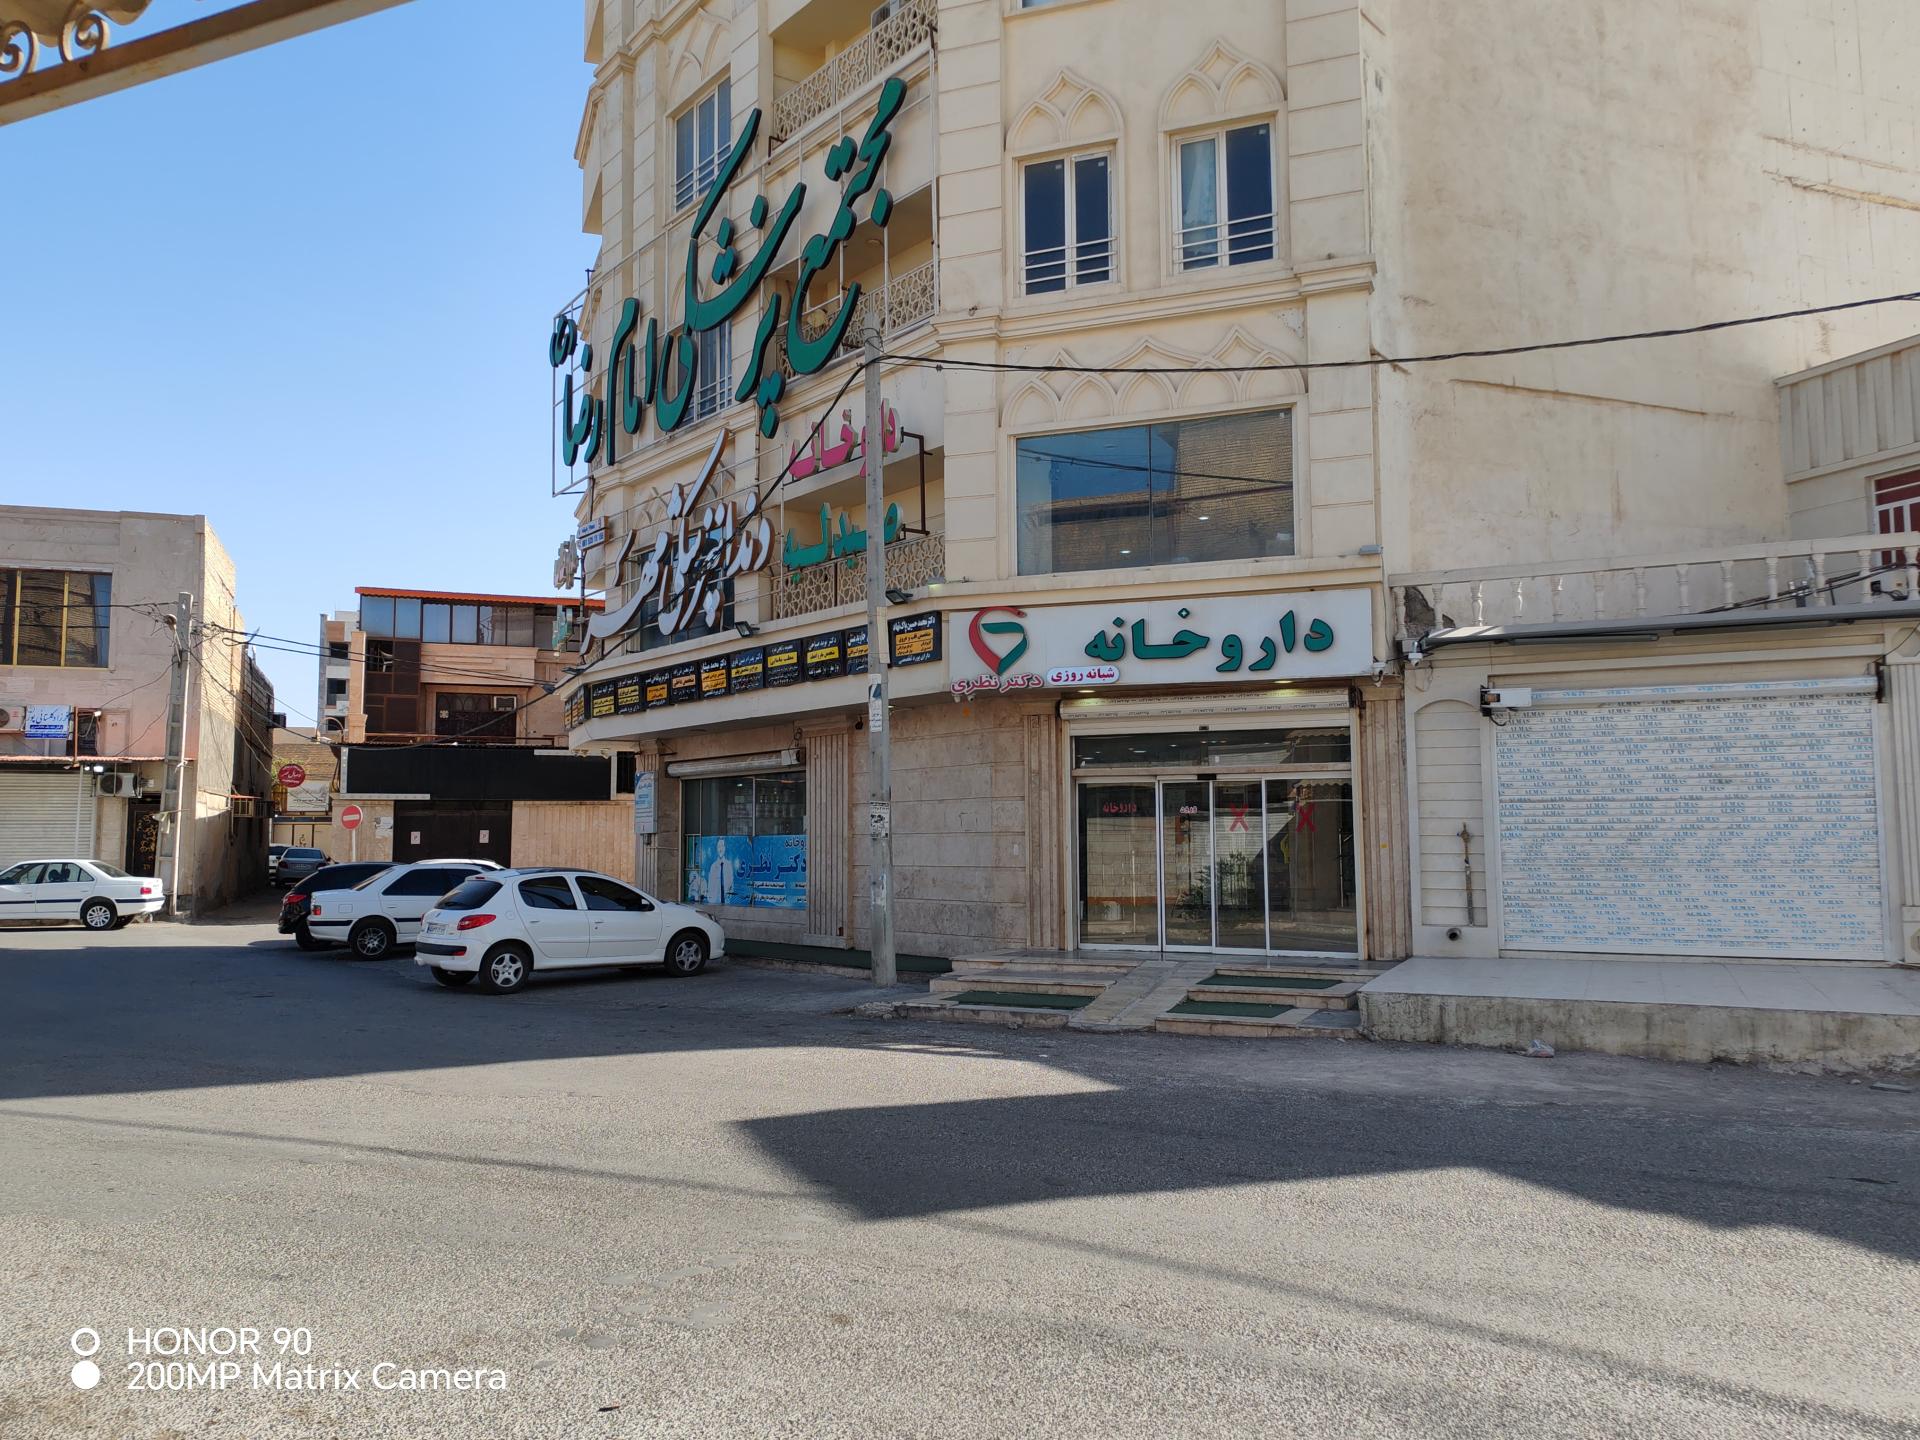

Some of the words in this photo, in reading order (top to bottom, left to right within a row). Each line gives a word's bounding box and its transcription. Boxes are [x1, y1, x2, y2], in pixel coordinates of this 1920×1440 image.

[788, 77, 907, 375] مجتمع
[606, 298, 658, 466] امام
[925, 615, 935, 626] دکتر
[1084, 608, 1334, 672] داروخانه
[951, 674, 999, 694] نظری
[1000, 675, 1044, 693] دکتر
[1051, 671, 1083, 683] روزی
[1086, 667, 1115, 680] شبانه
[736, 850, 772, 879] نظری
[774, 853, 807, 880] دکتر
